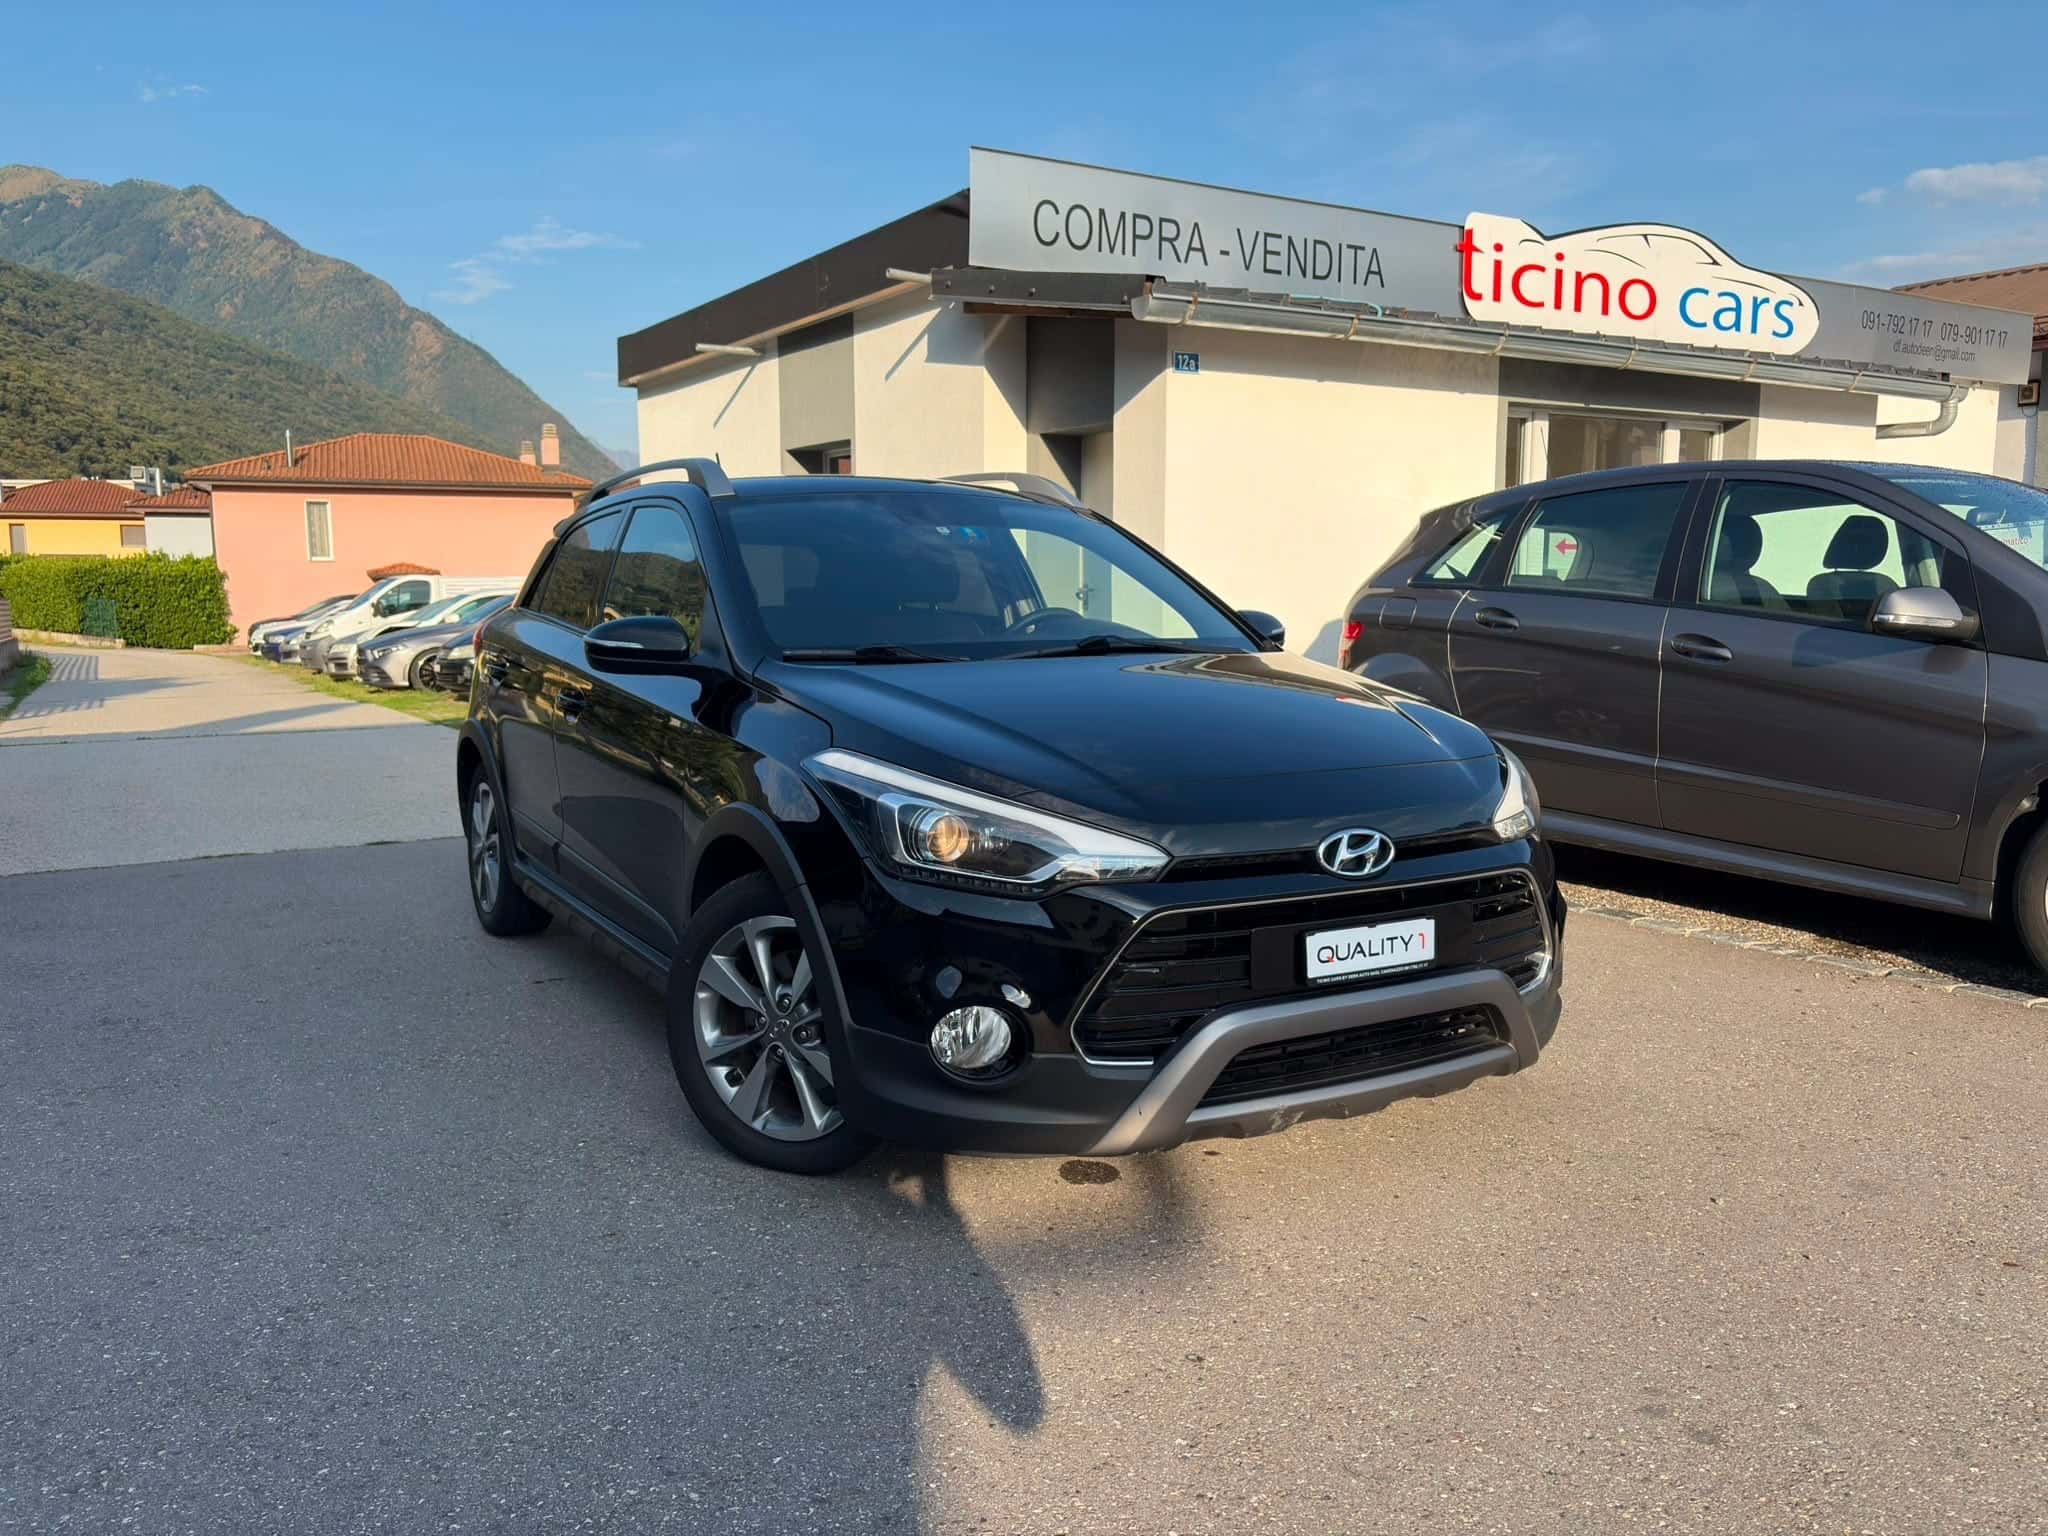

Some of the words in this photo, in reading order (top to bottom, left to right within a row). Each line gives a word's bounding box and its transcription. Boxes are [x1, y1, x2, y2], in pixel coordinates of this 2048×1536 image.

[1033, 199, 1208, 267] COMPRA
[1236, 227, 1385, 288] VENDITA
[1456, 228, 1657, 320] ticino
[1679, 286, 1795, 338] cars
[1861, 310, 1906, 335] 091-792
[1909, 316, 1920, 337] 17
[1922, 319, 1934, 339] 17
[1940, 322, 1982, 345] 079-901
[1985, 328, 1996, 348] 17
[1998, 330, 2008, 349] 17
[1177, 354, 1196, 371] 12a
[1317, 933, 1414, 964] QUALITY
[1418, 932, 1425, 950] 1
